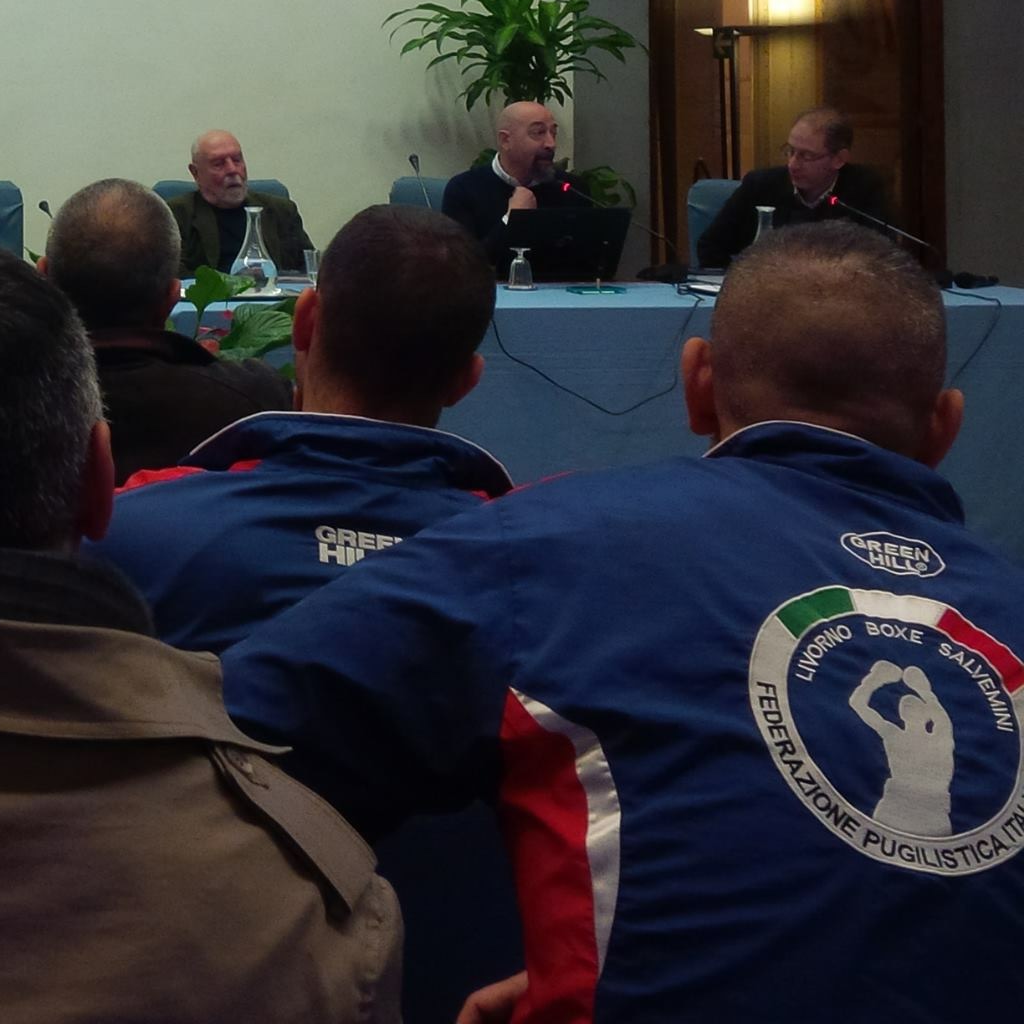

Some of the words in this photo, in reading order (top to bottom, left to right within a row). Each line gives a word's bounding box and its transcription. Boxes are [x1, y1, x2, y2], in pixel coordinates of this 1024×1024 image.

[314, 525, 403, 551] GREE
[850, 536, 930, 562] GREEN
[795, 624, 853, 682] LIVORNO
[866, 621, 924, 645] BOXE
[938, 642, 1014, 732] SALVEMINI
[756, 681, 860, 839] FEDERAZIONE
[862, 831, 1009, 869] PUGILISTICA
